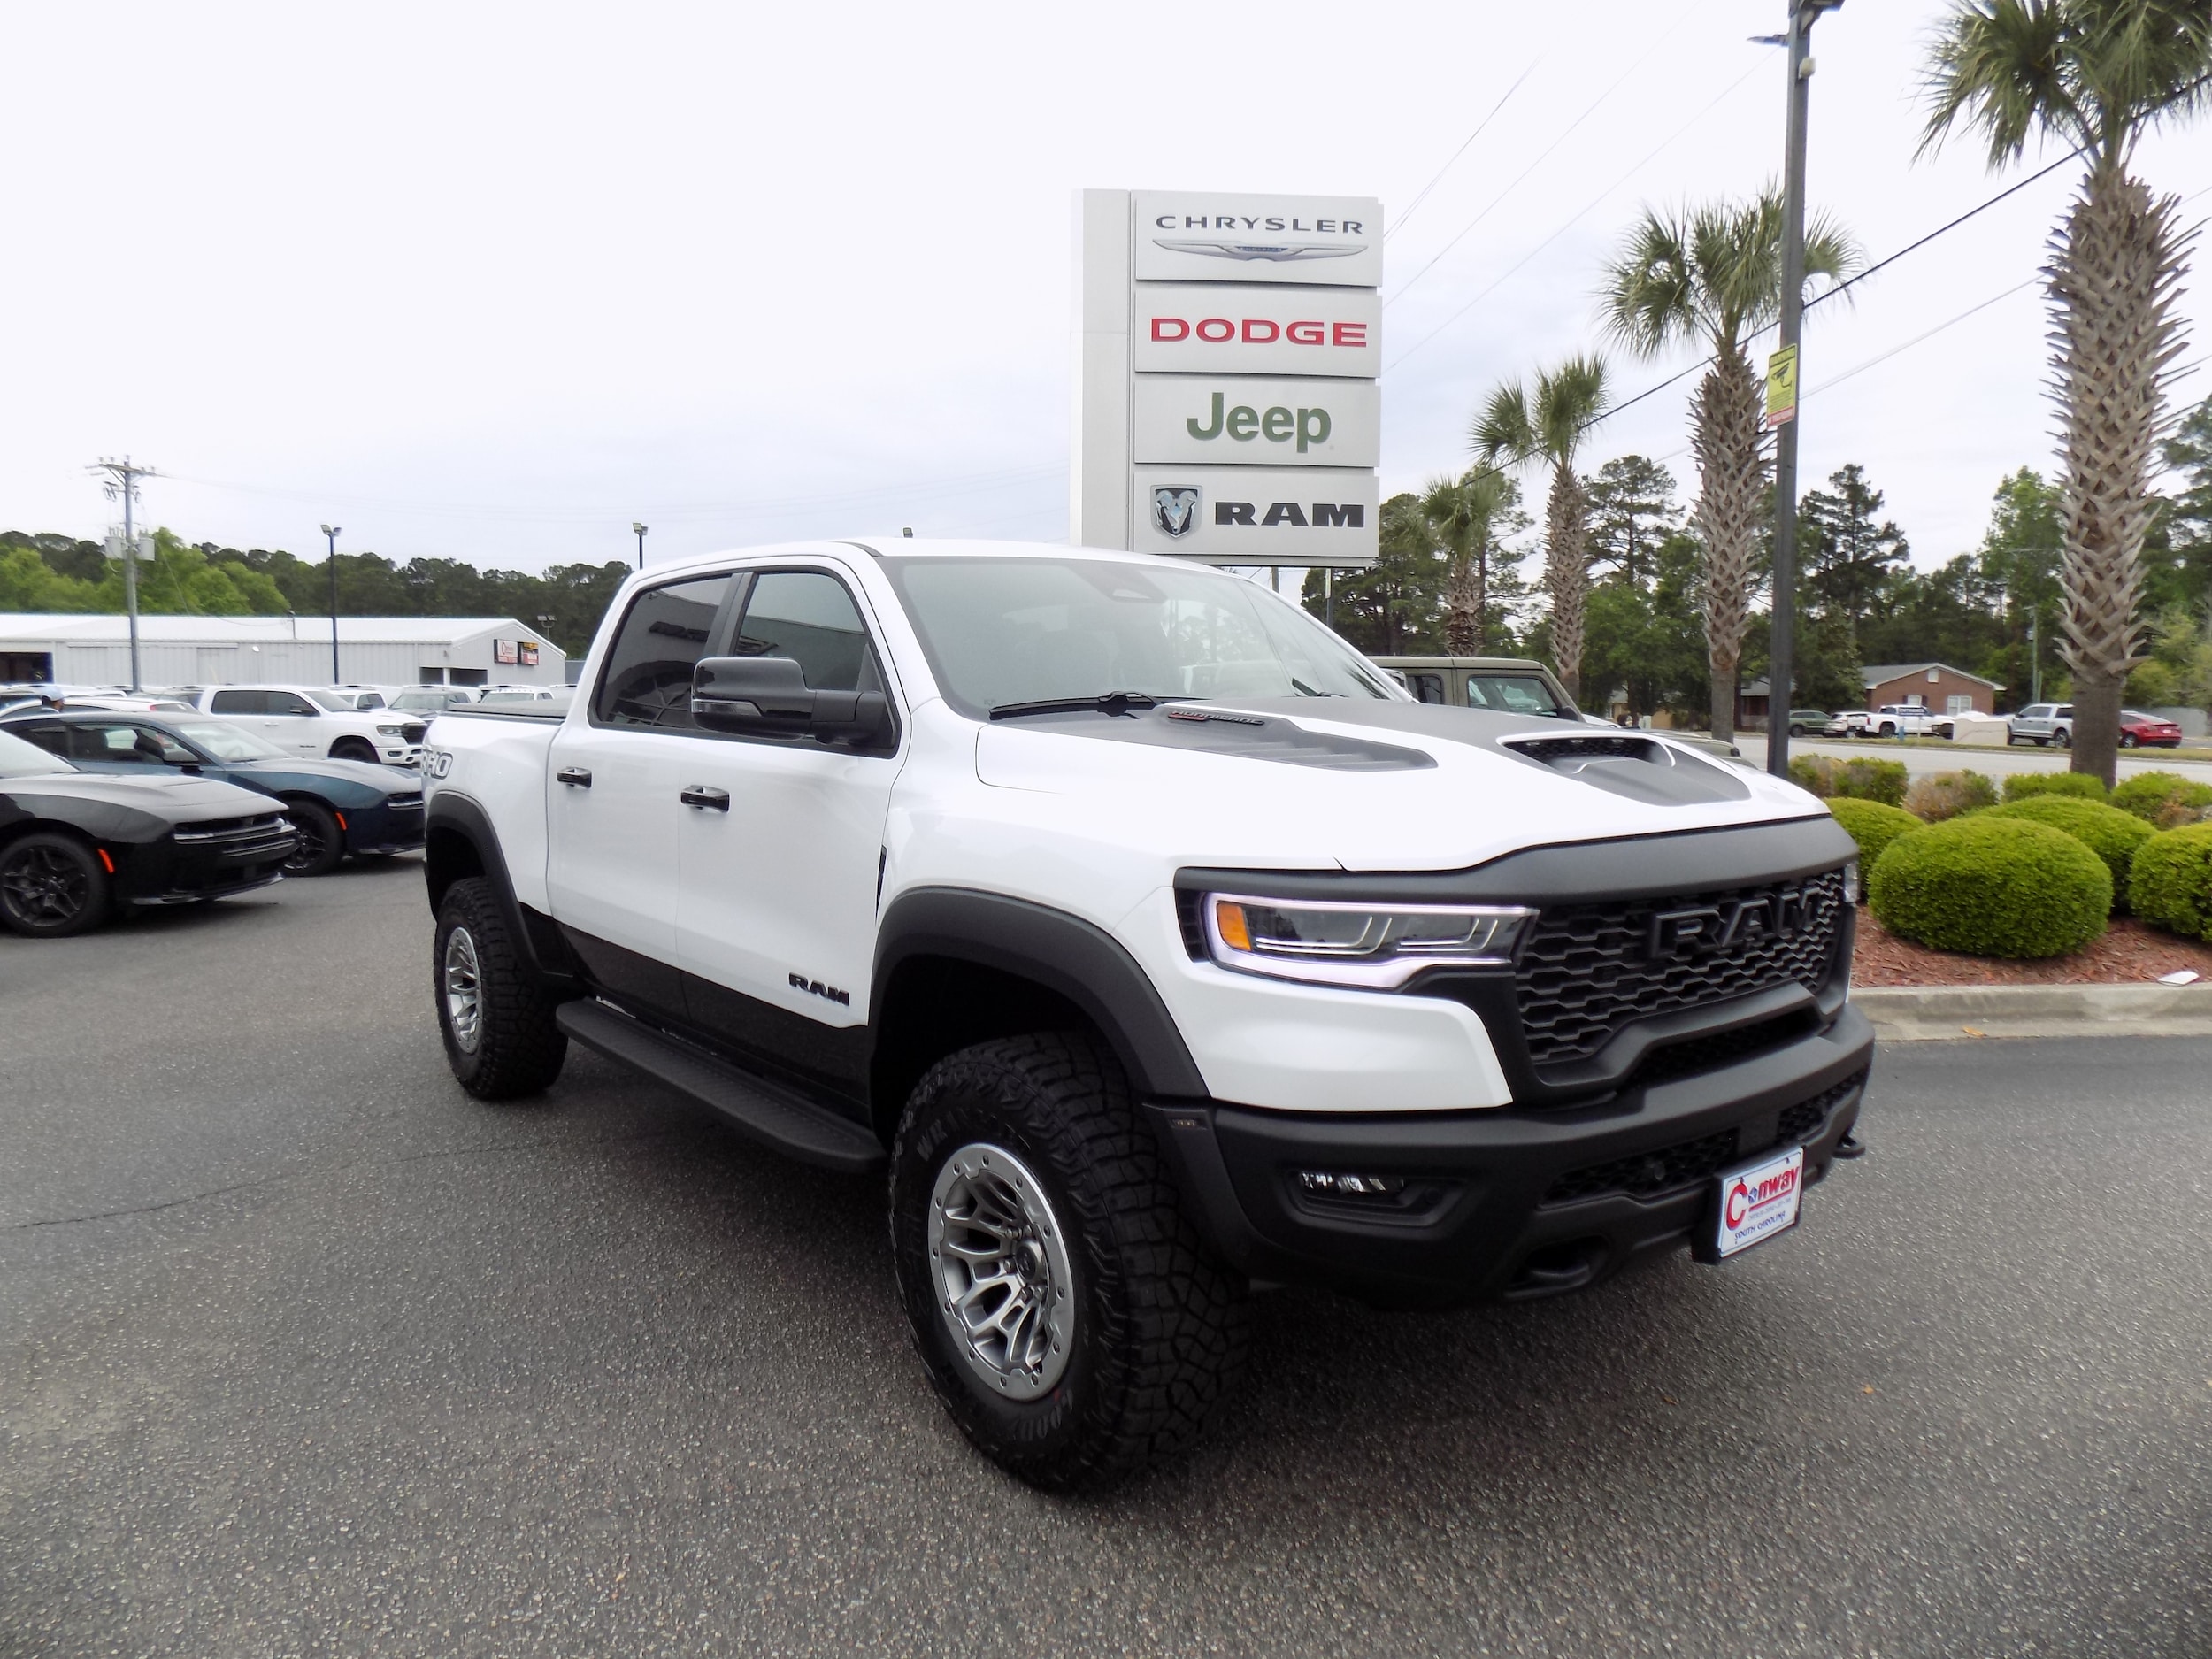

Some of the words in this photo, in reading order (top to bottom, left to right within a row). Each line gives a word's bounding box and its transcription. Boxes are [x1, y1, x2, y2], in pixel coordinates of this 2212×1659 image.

[1156, 216, 1363, 234] CHRYSLER
[1151, 318, 1367, 348] DODGE
[1187, 392, 1332, 453] Jeep
[1215, 501, 1364, 528] RAM
[1654, 887, 1823, 956] RAM
[788, 972, 849, 1007] RAM
